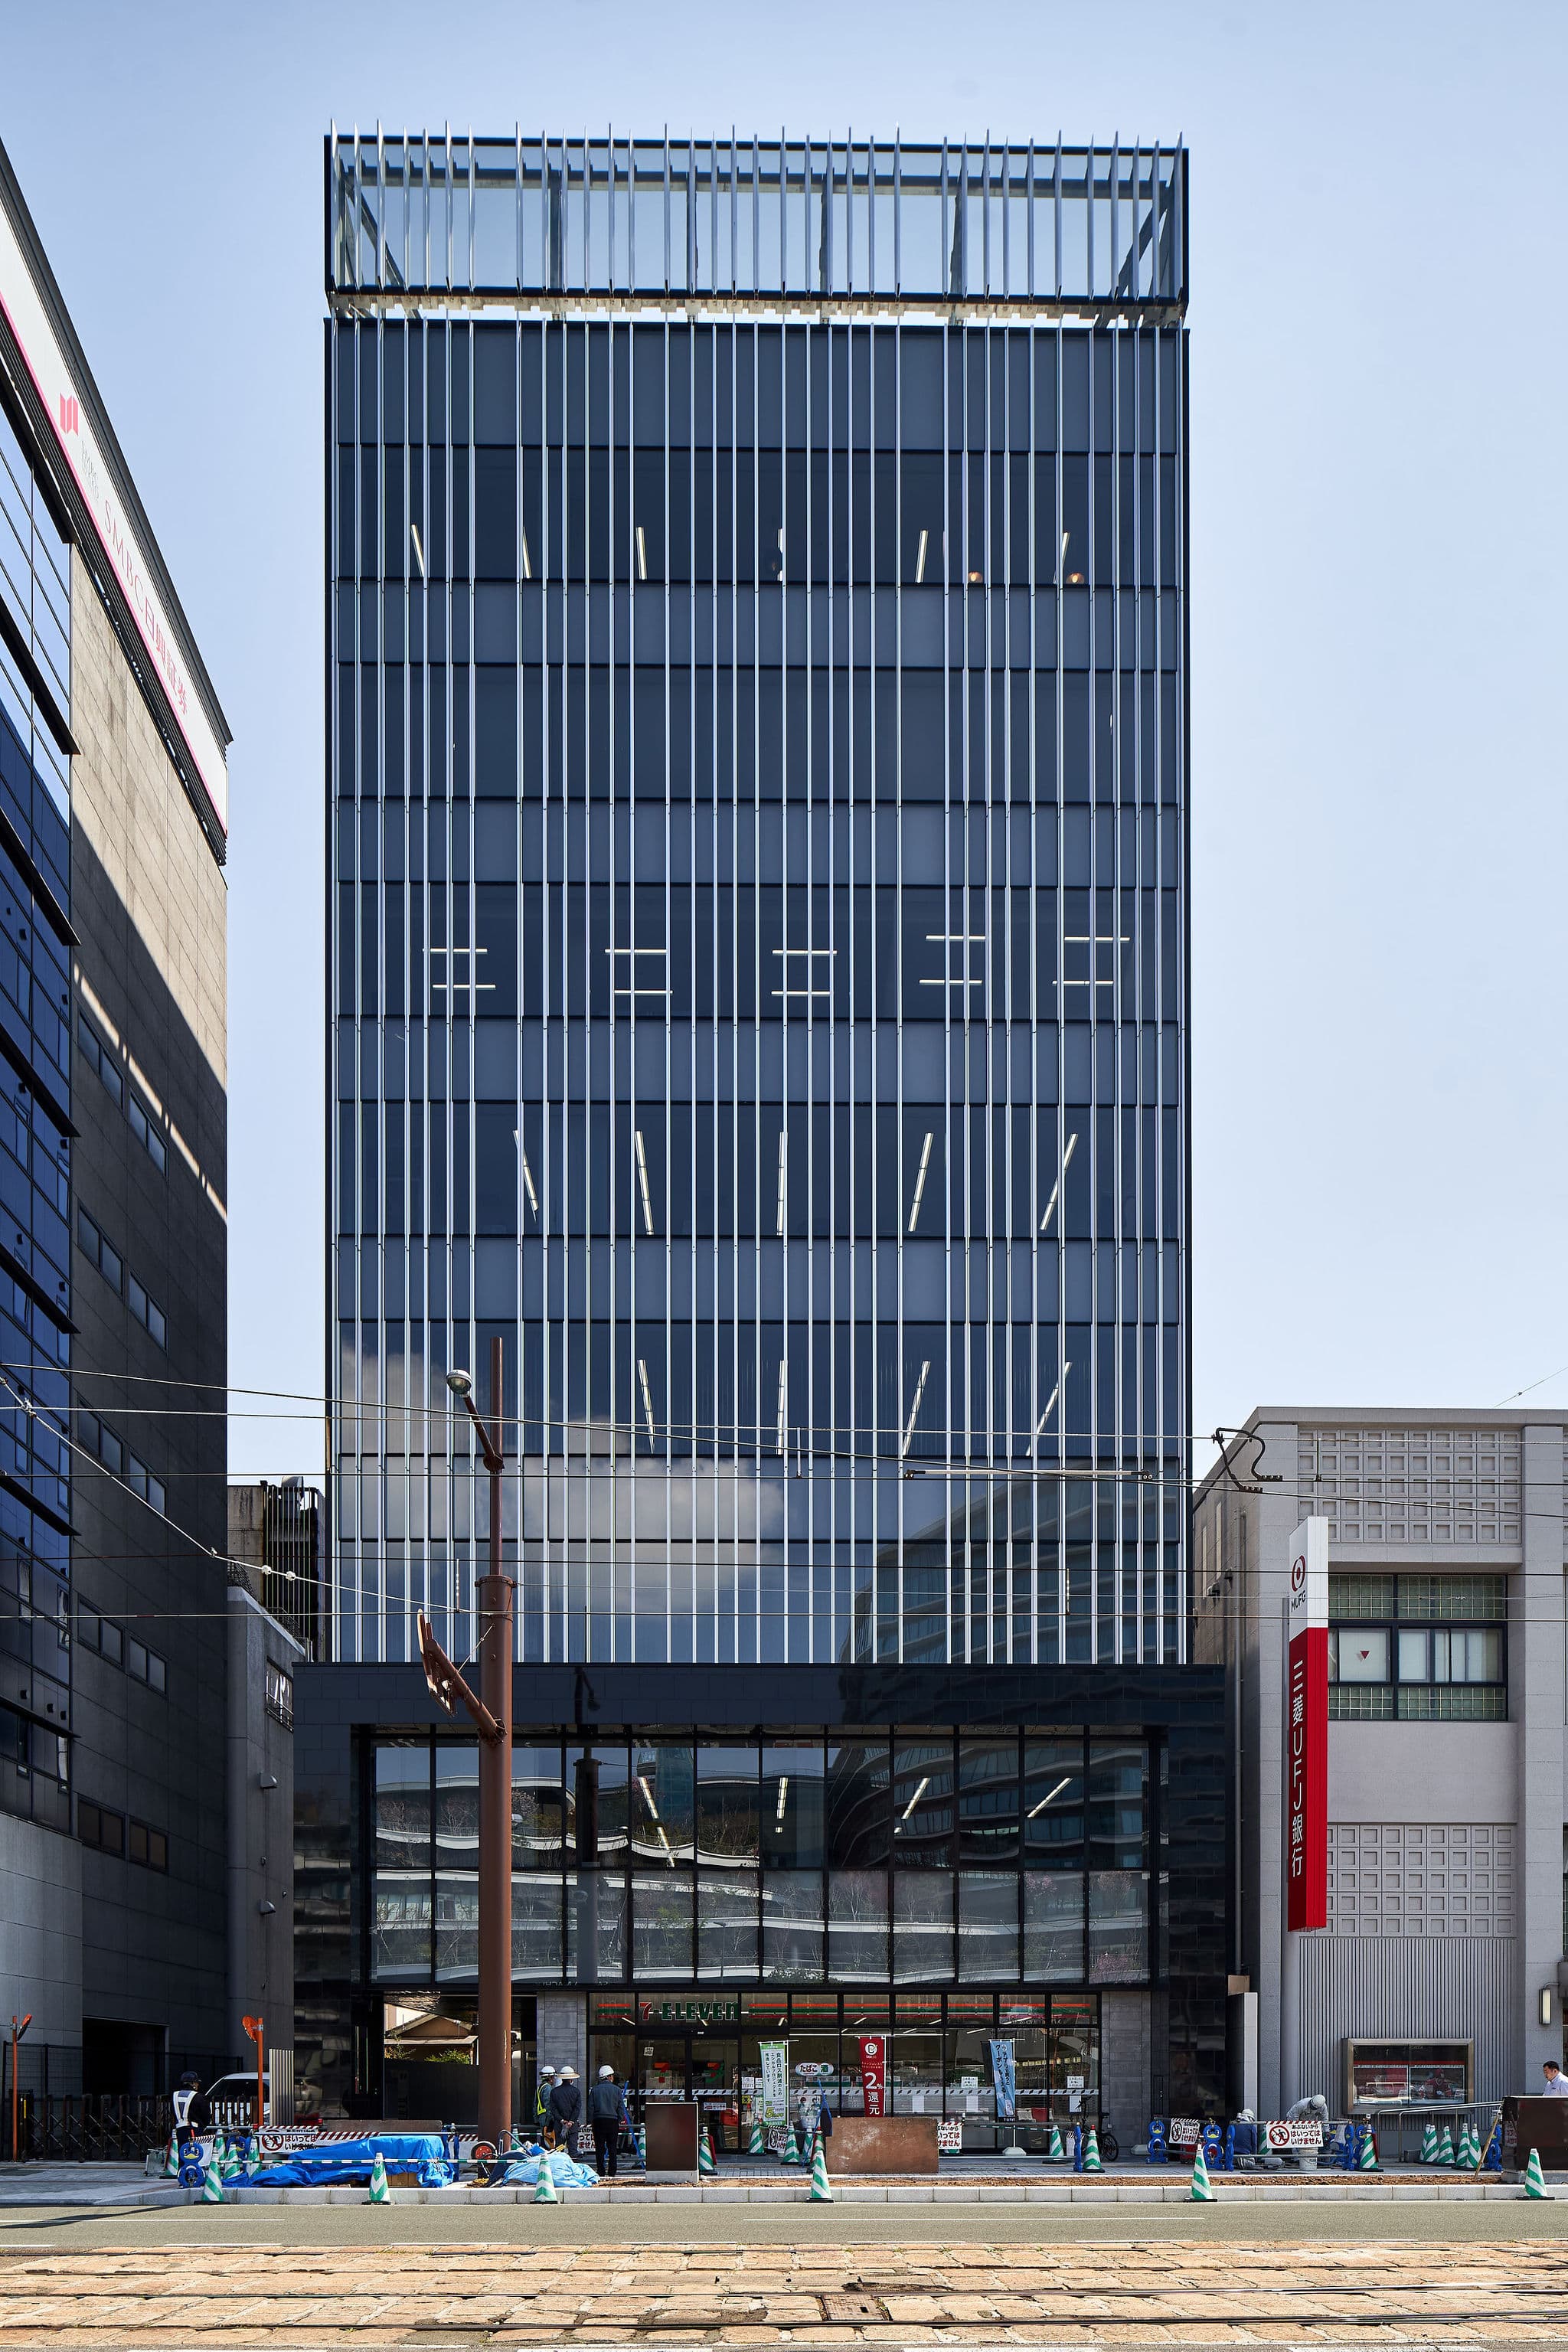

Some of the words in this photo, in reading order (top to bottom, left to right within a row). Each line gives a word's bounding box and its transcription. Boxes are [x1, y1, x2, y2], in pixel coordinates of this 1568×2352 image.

[1291, 1589, 1306, 1612] MUFG
[1292, 1660, 1304, 1879] 三菱UFJ銀行
[800, 2064, 818, 2073] たばこ
[867, 2091, 880, 2115] 還元
[1291, 2137, 1321, 2145] いけません
